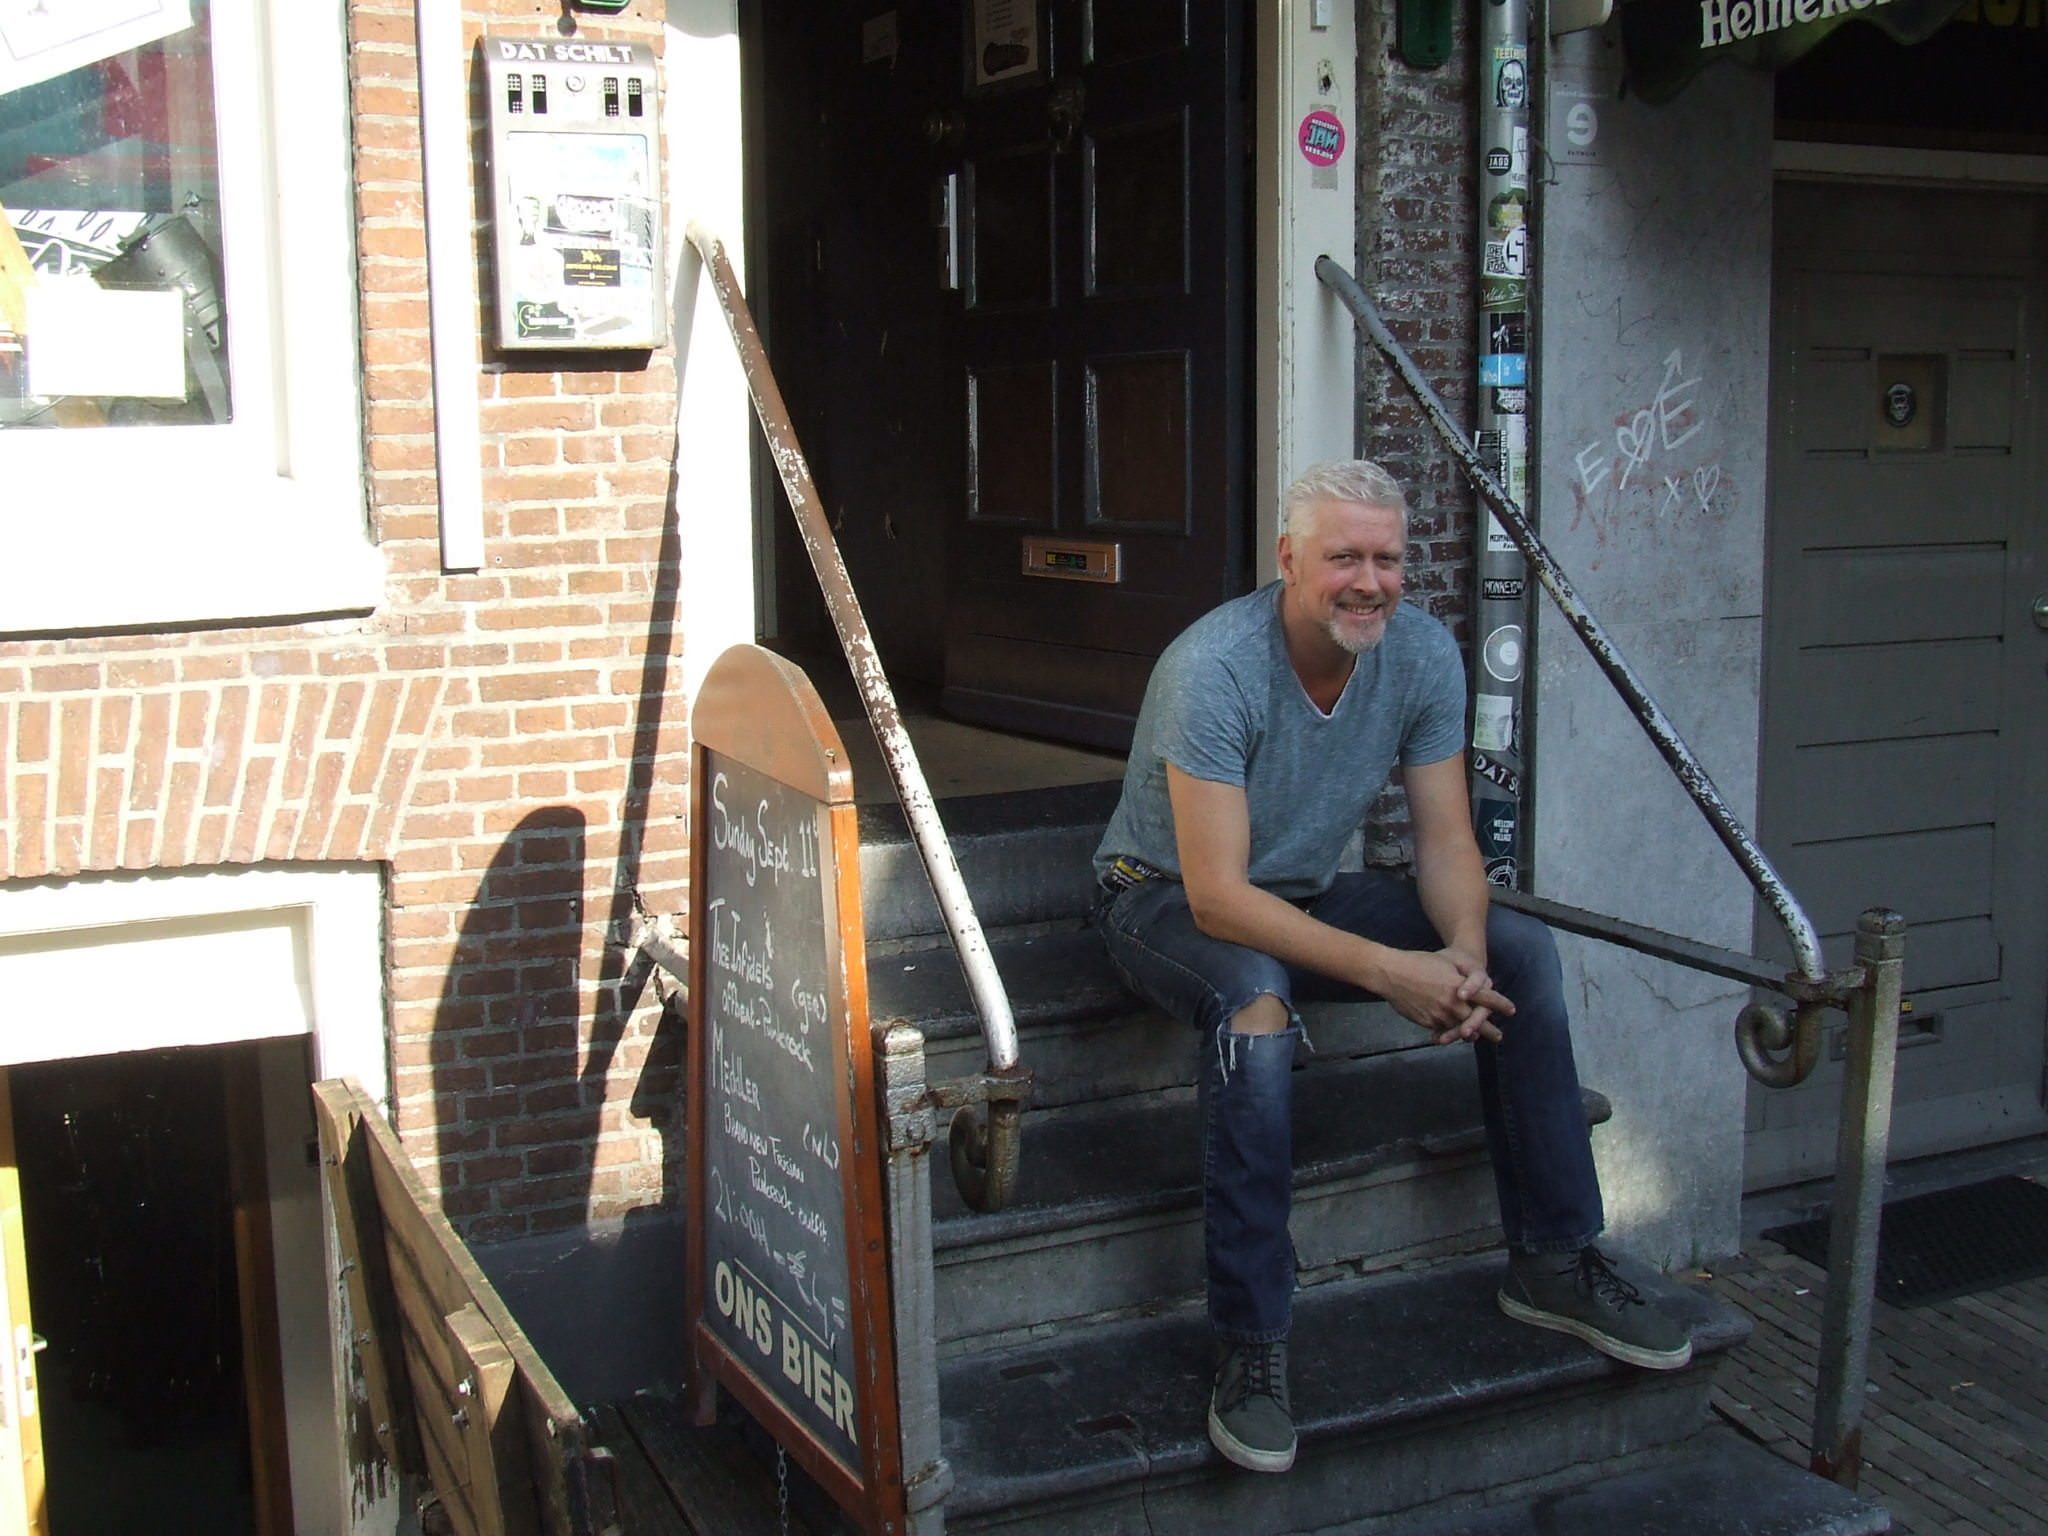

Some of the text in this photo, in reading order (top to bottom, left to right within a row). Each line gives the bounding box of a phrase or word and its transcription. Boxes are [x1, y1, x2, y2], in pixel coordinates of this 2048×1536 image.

[498, 40, 634, 64] DAT SCHILT
[1474, 754, 1508, 785] DAT
[715, 1260, 857, 1447] ONS BIER
